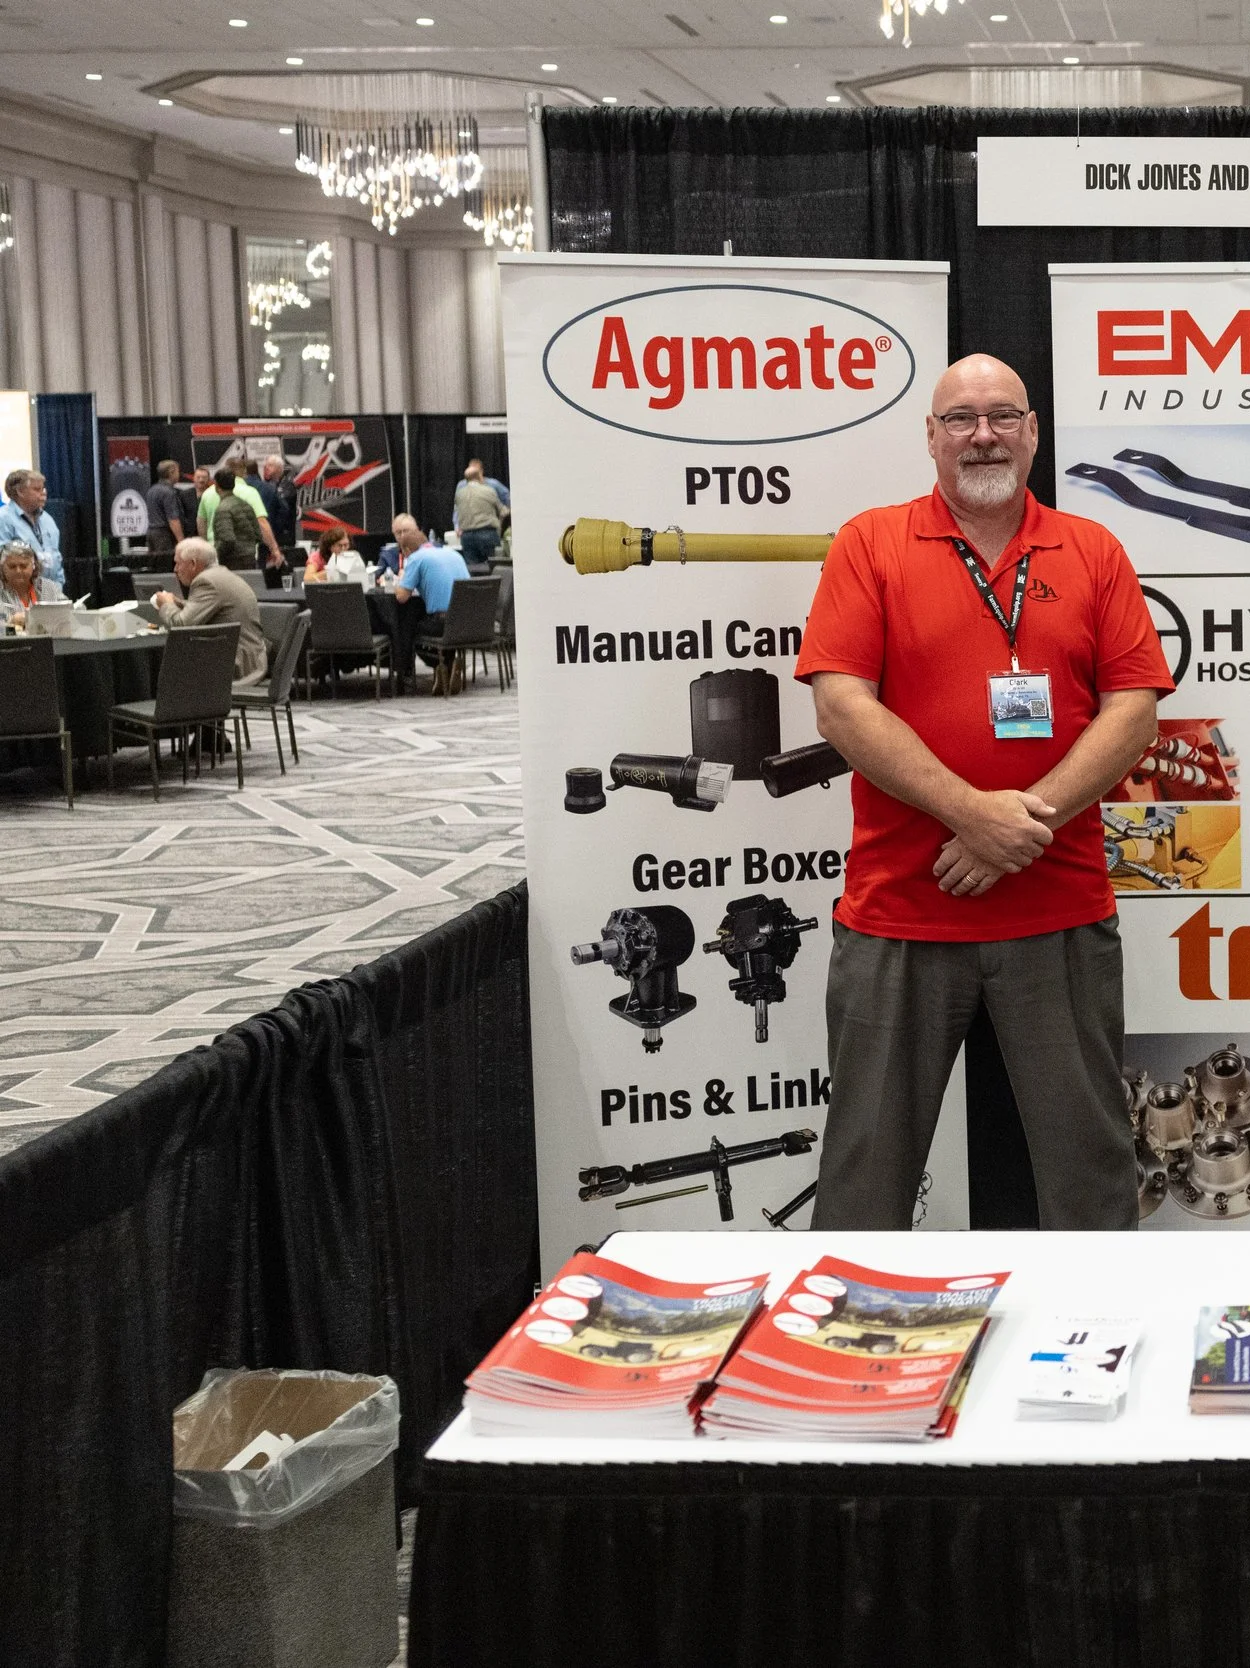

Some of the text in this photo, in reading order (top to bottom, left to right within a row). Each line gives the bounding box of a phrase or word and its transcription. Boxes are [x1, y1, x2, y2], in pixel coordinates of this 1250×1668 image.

[1086, 164, 1131, 191] DICK
[1137, 164, 1201, 192] JONES
[1207, 165, 1249, 192] AND
[686, 466, 791, 506] PTOS
[555, 617, 809, 664] Manual Can
[633, 852, 732, 893] Gear
[601, 1085, 692, 1126] Pins
[703, 1078, 735, 1116] &
